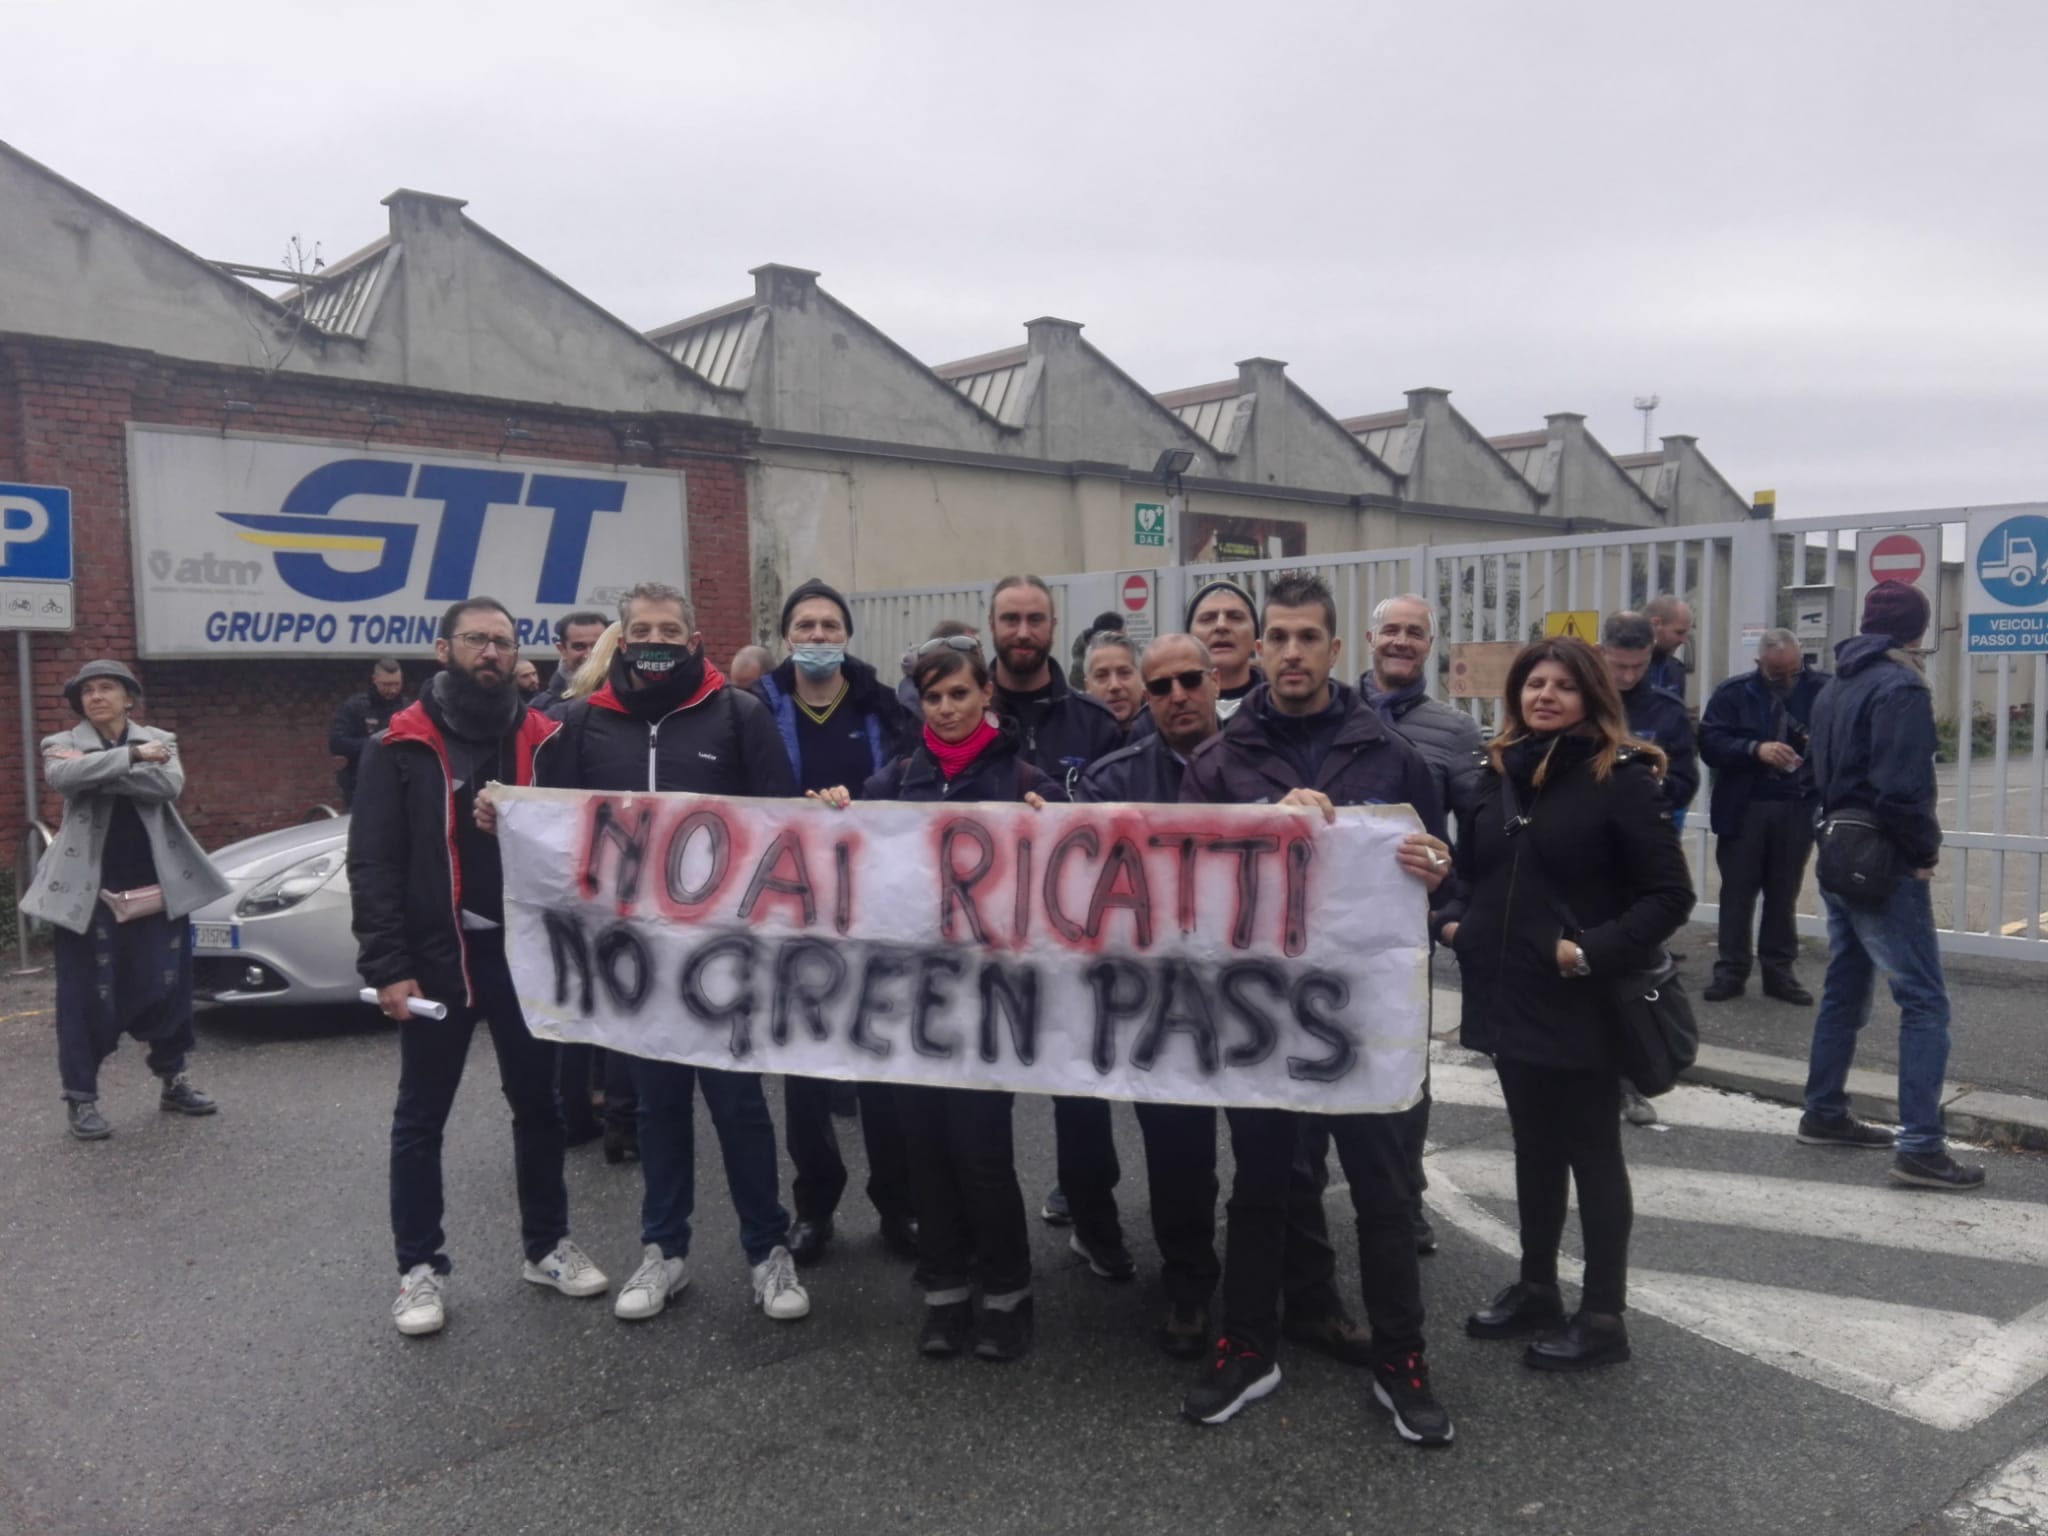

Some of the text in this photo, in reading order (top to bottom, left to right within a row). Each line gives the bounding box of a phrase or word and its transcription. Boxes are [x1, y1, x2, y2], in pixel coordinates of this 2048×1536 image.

[0, 495, 49, 566] P
[215, 459, 627, 602] GTT
[1139, 534, 1160, 545] DAE
[174, 552, 262, 585] atm
[205, 611, 337, 644] GRUPPO
[348, 614, 443, 644] TORIN
[1971, 634, 2016, 646] PASSO
[1990, 617, 2044, 631] VEICOLI
[636, 660, 675, 671] GREEN
[938, 815, 1313, 959] RICATTI
[545, 908, 1358, 1083] NO GREEN PASS
